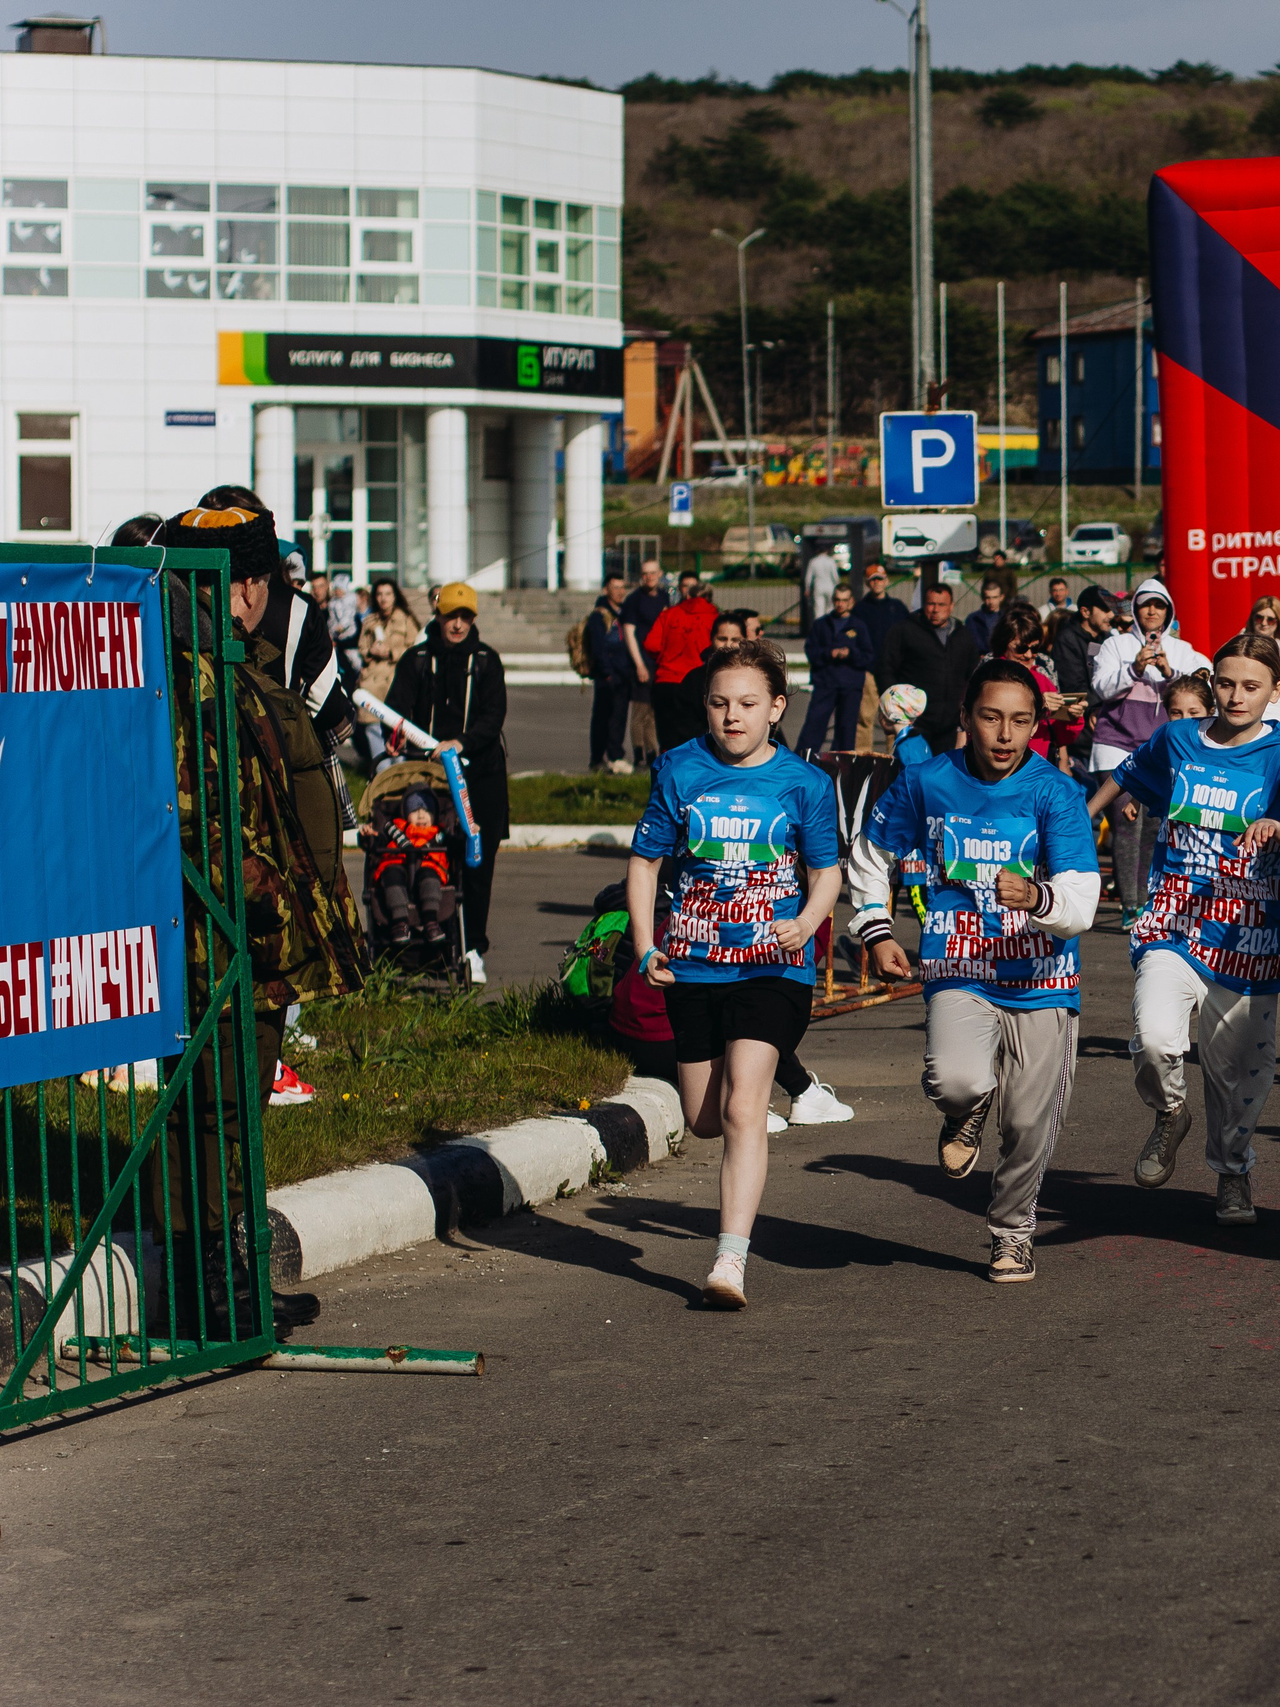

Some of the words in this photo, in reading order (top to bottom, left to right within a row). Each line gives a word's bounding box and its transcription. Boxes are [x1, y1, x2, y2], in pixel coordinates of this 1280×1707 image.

[350, 351, 381, 368] ДЛЯ
[390, 351, 454, 368] БИЗНЕСА
[1188, 529, 1206, 551] В
[12, 601, 145, 693] #МОМЕНТ
[1191, 784, 1238, 811] 10100
[710, 816, 761, 840] 10017
[963, 838, 1012, 861] 10013
[681, 896, 774, 923] #ГОРДОСТЬ
[1153, 891, 1266, 928] #ГОРДОСТЬ
[945, 932, 1055, 960] #ГОРДОСТЬ
[1235, 927, 1280, 955] 2024
[50, 925, 161, 1029] #МЕЧТА
[1032, 952, 1076, 980] 2024
